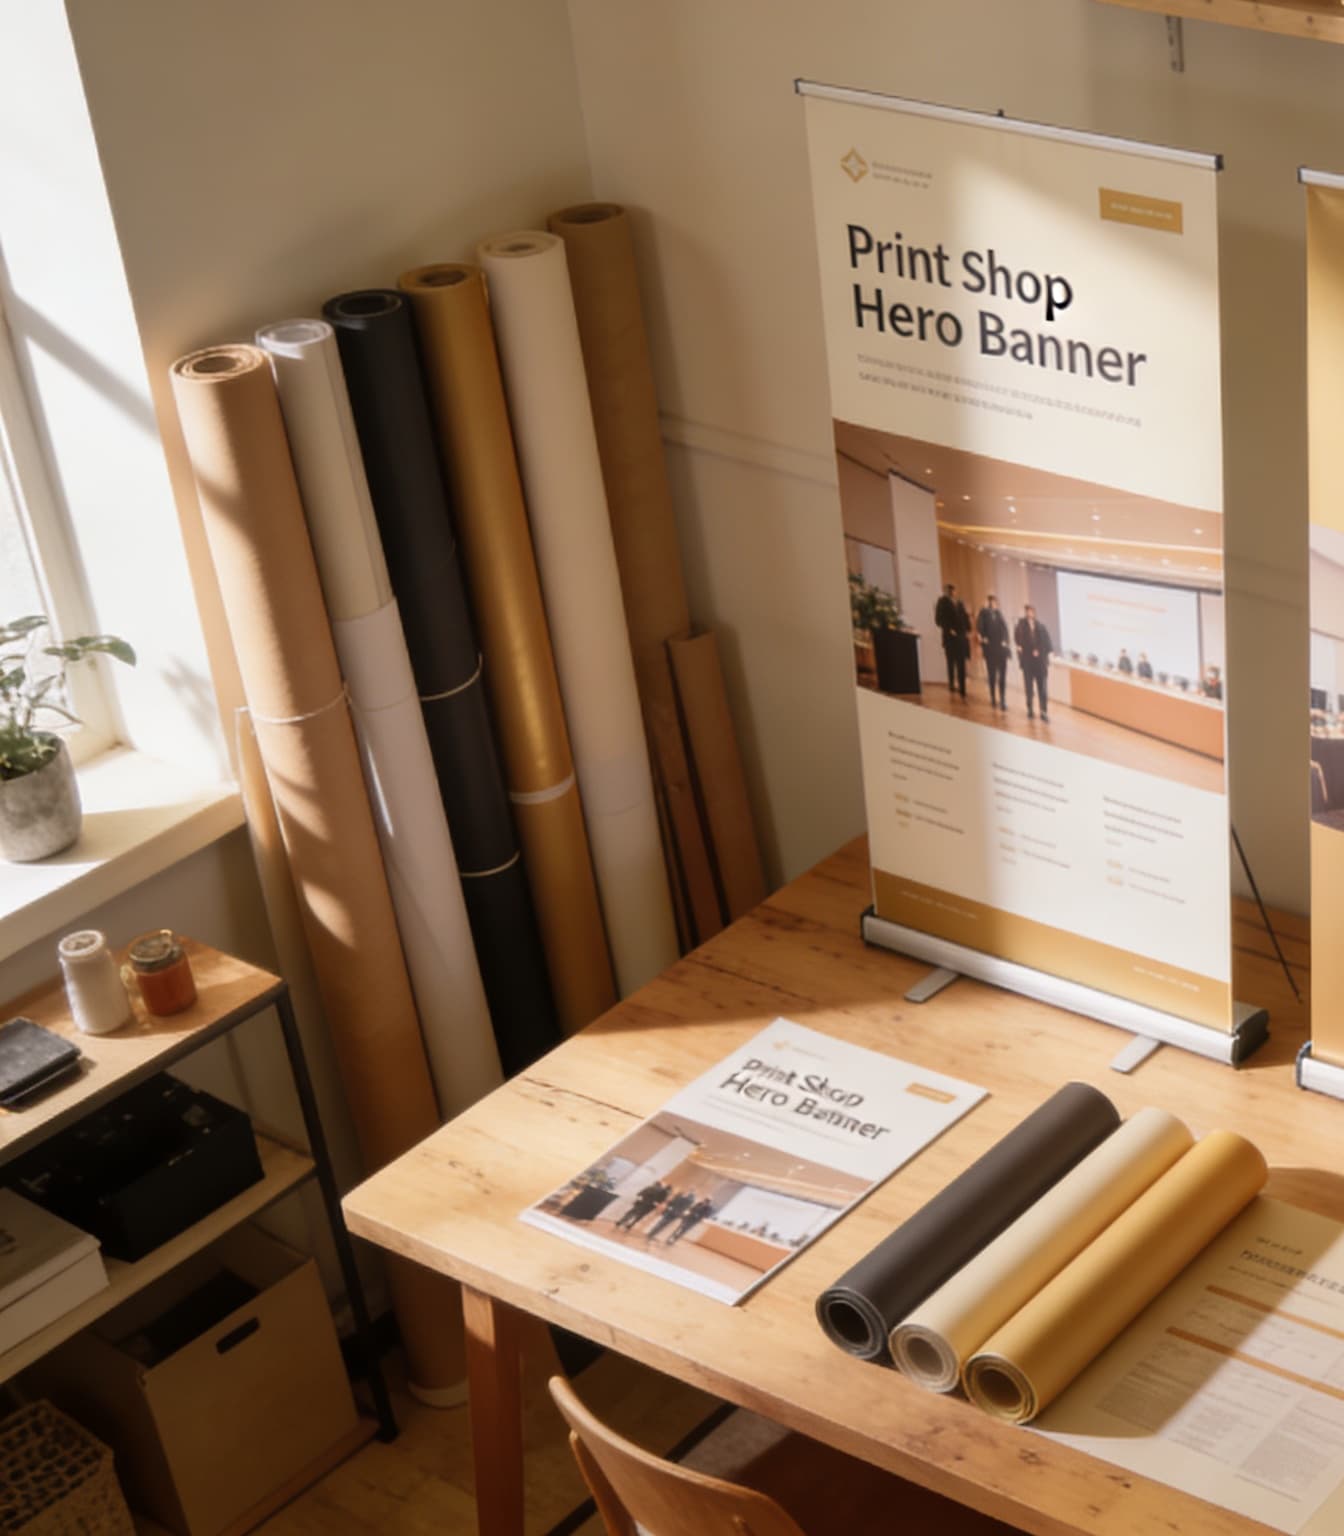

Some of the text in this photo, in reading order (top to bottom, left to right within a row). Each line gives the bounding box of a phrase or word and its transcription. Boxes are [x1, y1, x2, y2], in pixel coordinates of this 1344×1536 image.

[847, 223, 1074, 322] Print Shop
[853, 283, 1147, 387] Hero Banner
